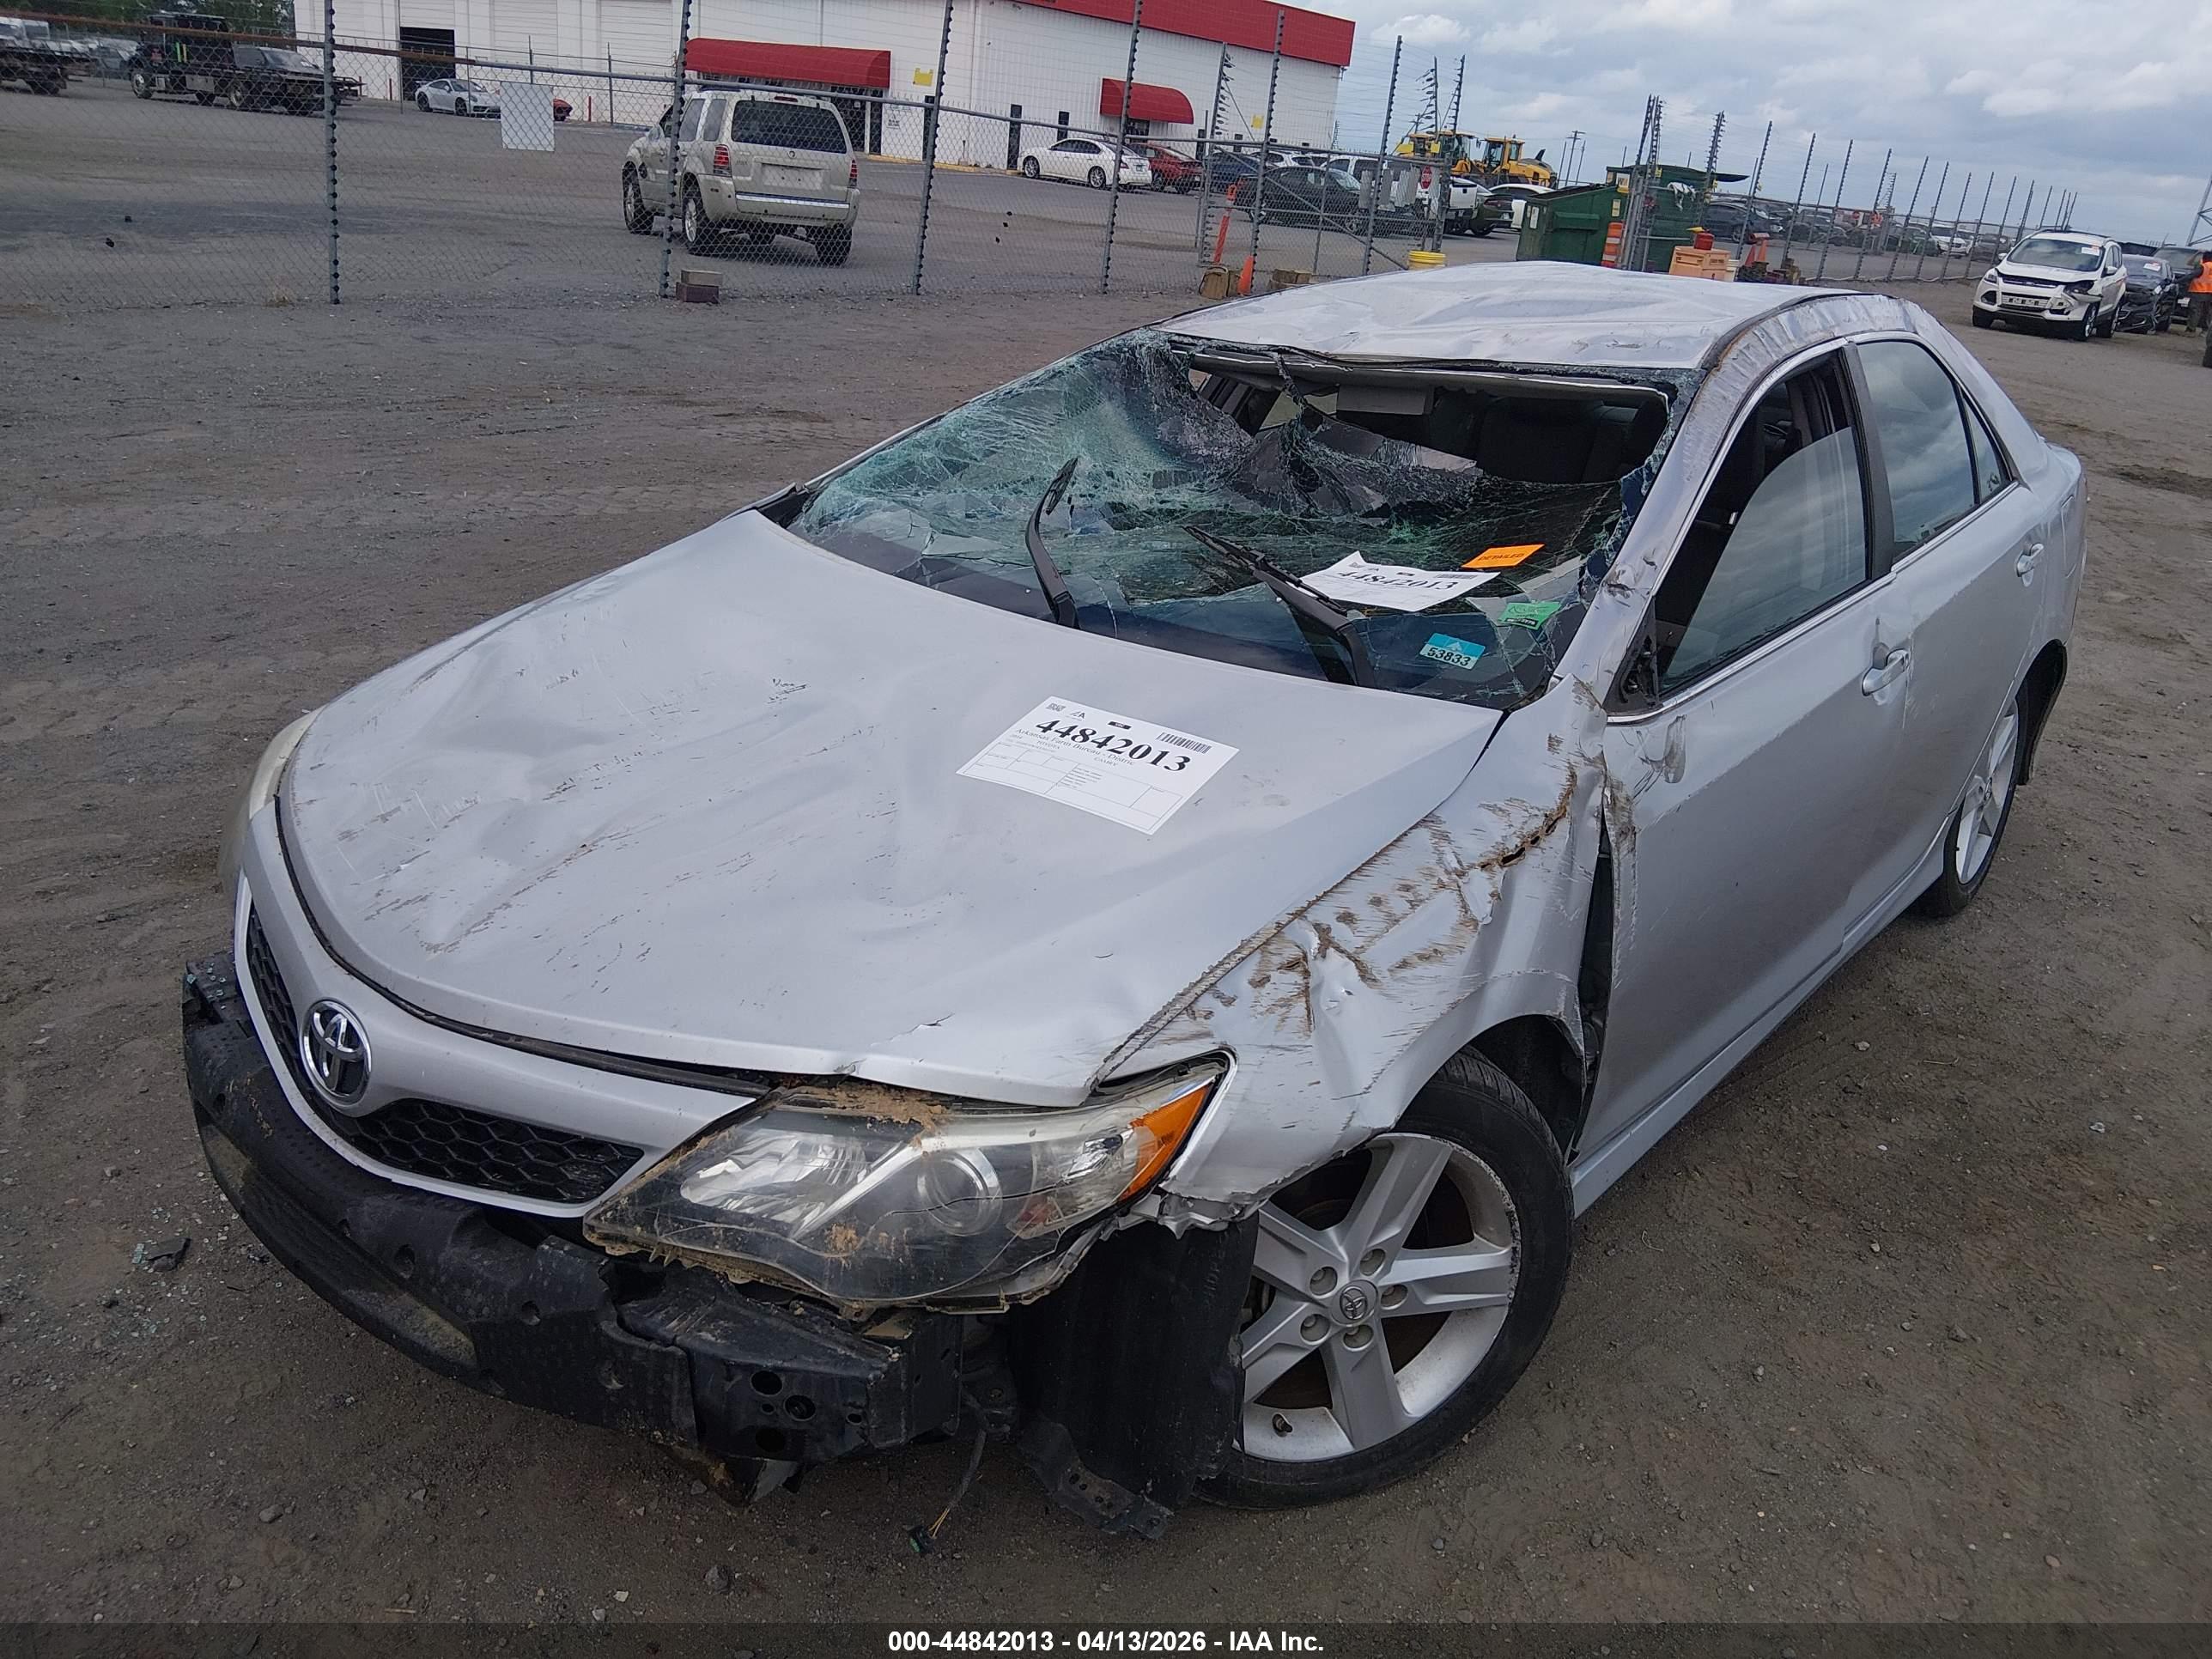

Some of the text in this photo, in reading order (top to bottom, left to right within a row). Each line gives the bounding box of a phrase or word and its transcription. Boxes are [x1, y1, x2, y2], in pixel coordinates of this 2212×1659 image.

[1338, 571, 1459, 590] 44842013
[1427, 647, 1472, 666] 53833
[1016, 728, 1049, 741] Arkansas
[1051, 737, 1072, 746] Farm
[1073, 743, 1101, 756] Bureau
[1107, 754, 1134, 765] Distric
[1036, 720, 1191, 772] 44842013
